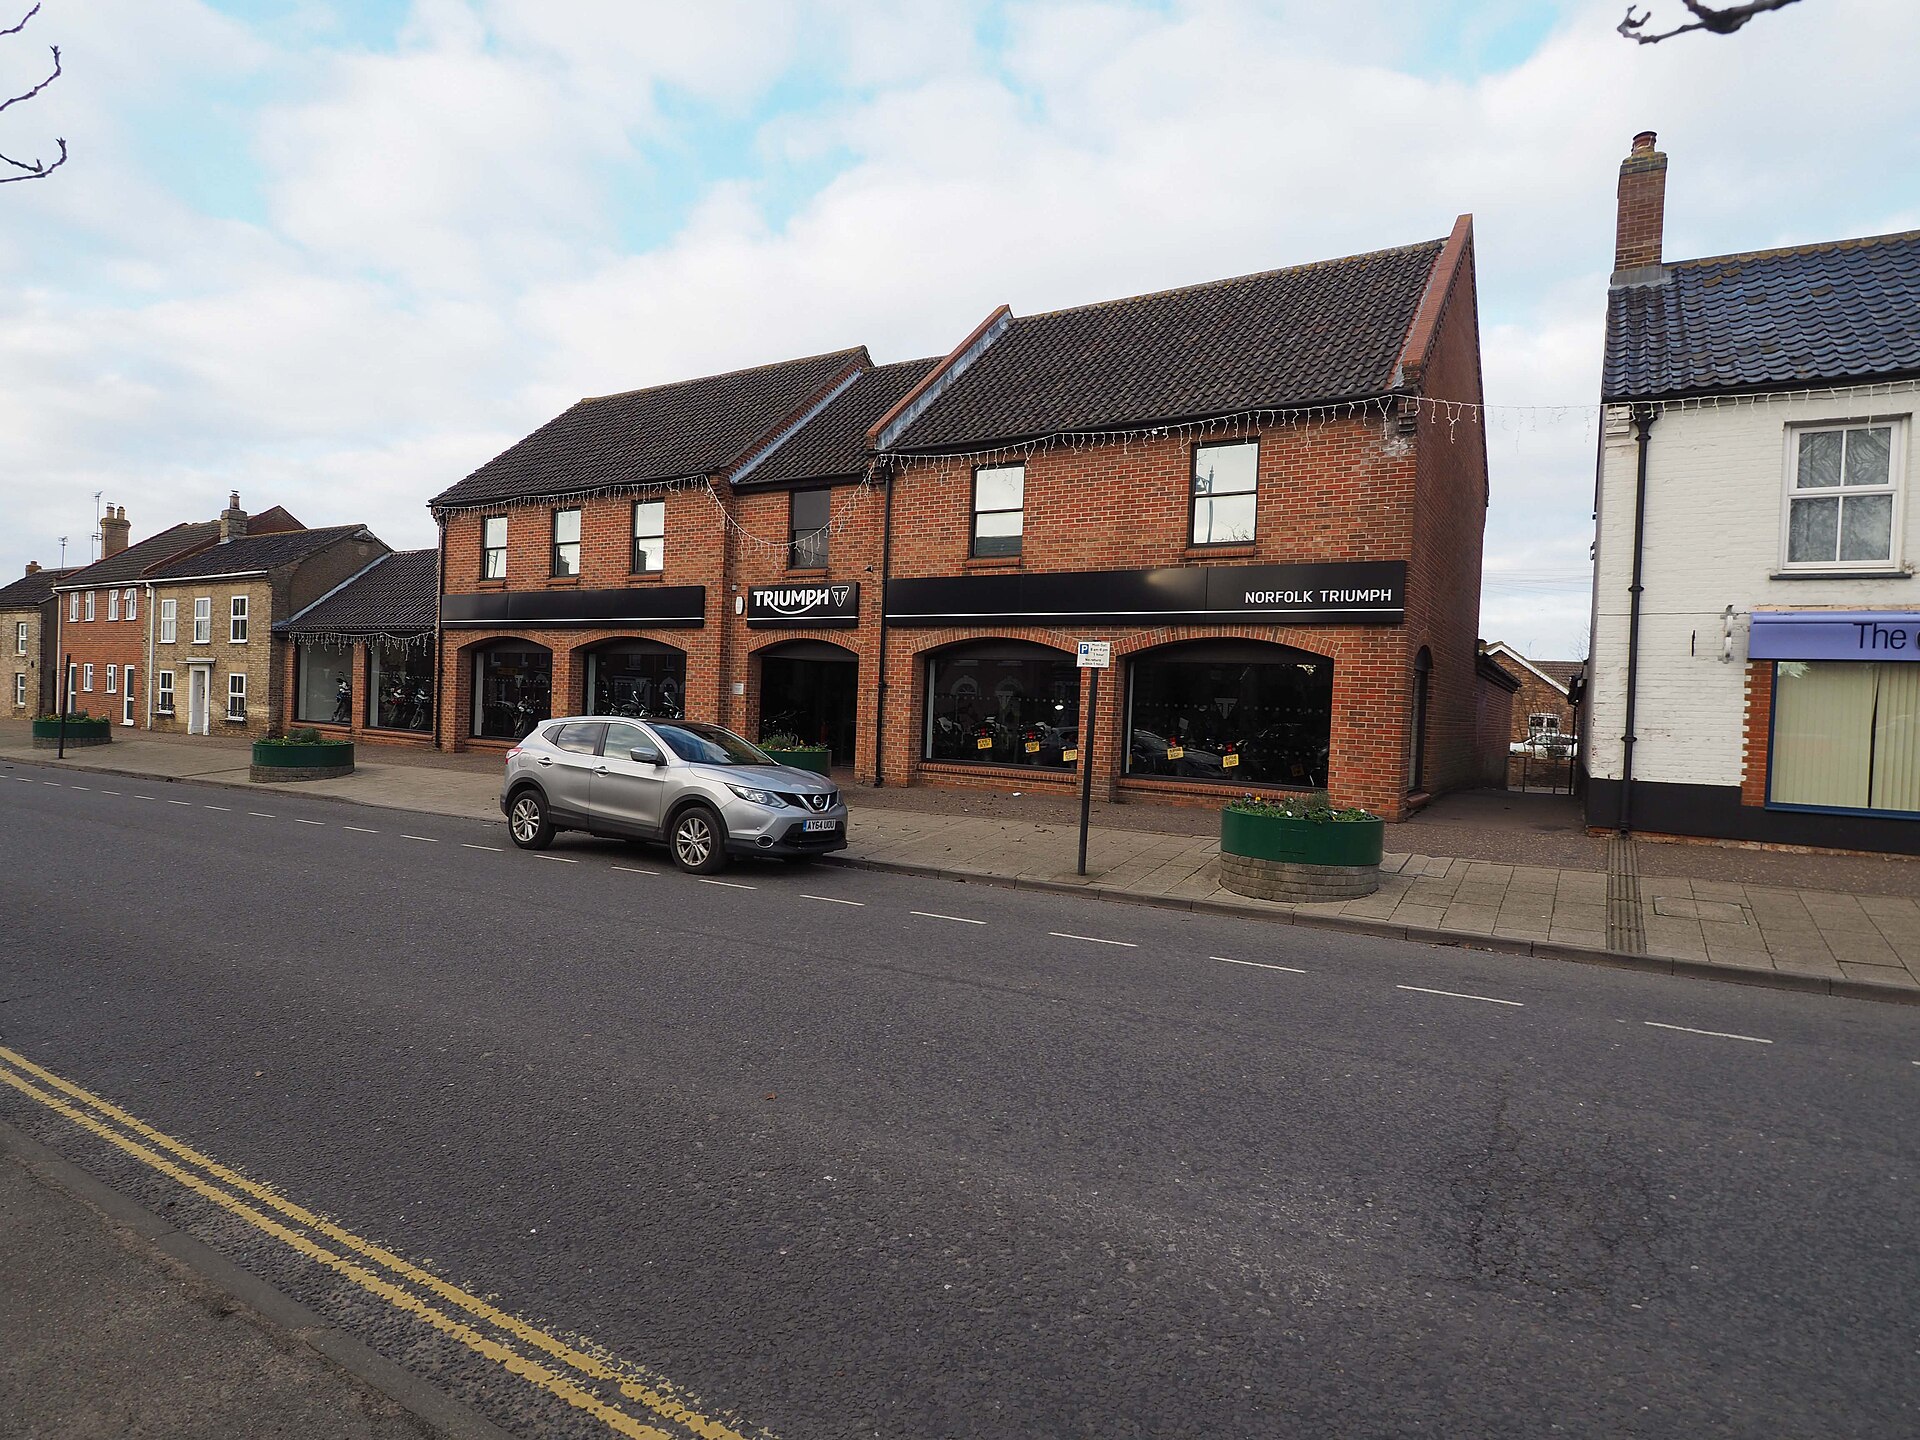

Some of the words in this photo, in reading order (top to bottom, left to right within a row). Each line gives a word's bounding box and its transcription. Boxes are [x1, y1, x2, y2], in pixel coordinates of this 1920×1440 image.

[753, 589, 829, 614] TRIUMPH
[1244, 590, 1314, 604] NORFOLK
[1320, 589, 1392, 603] TRIUMPH
[1852, 622, 1907, 650] The
[807, 821, 823, 830] AY64
